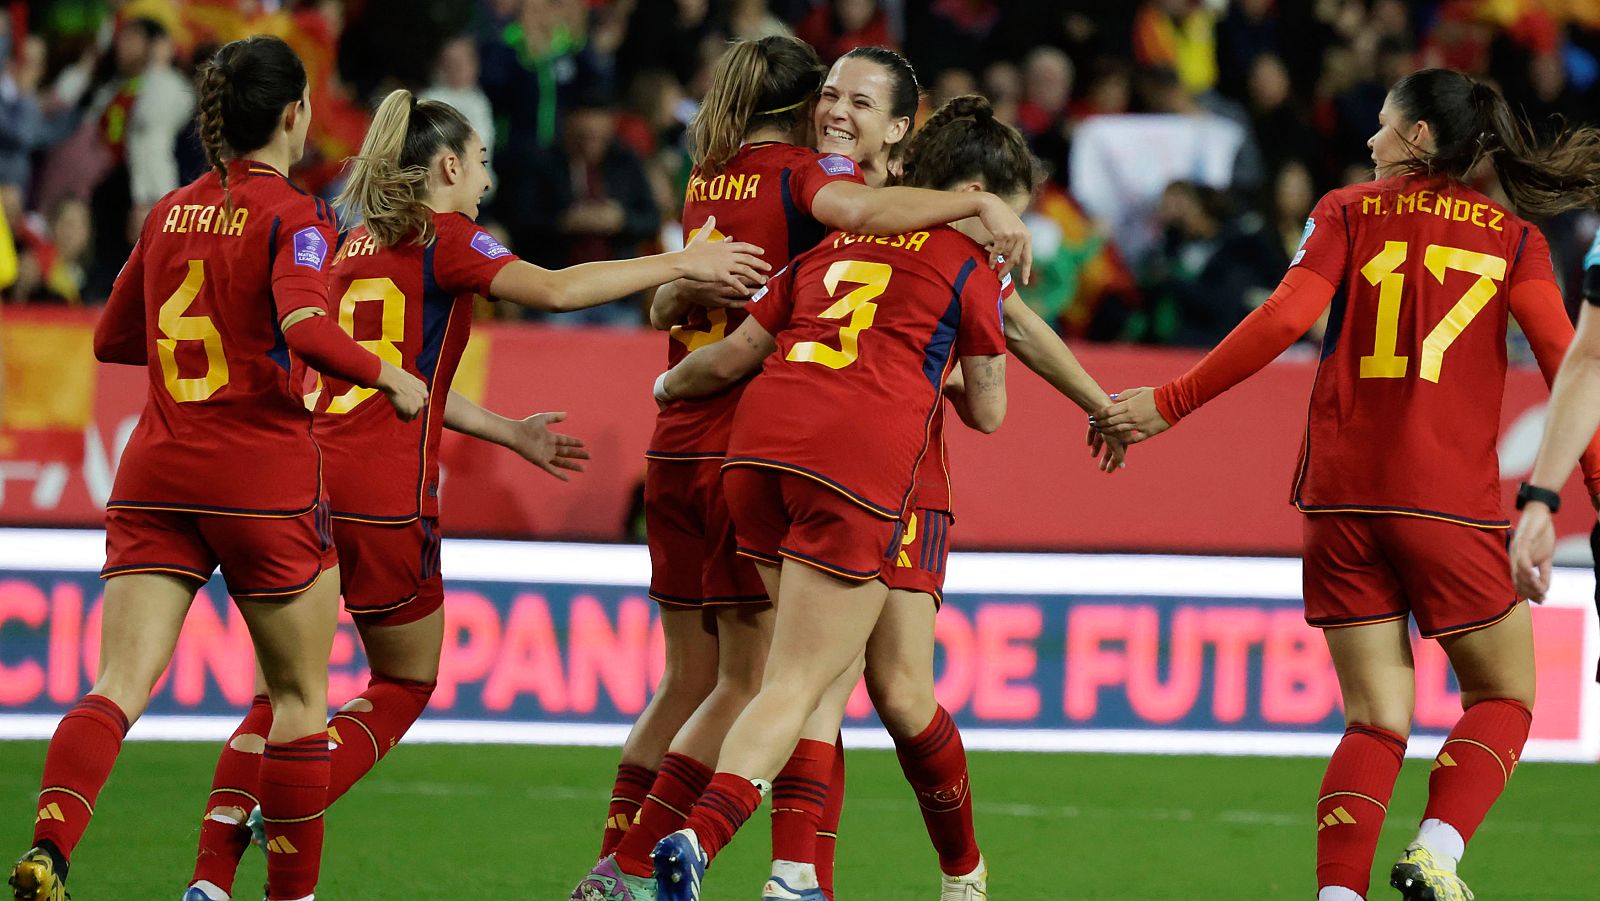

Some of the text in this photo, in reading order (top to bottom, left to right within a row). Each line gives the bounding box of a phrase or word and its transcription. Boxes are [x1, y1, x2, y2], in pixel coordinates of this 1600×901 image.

[162, 204, 249, 237] AITANA
[1362, 190, 1505, 231] M. MENDEZ
[156, 259, 230, 402] 6
[303, 277, 406, 415] 9
[785, 260, 893, 370] 3
[1359, 240, 1507, 384] 17
[1063, 604, 1463, 728] FUTBL
